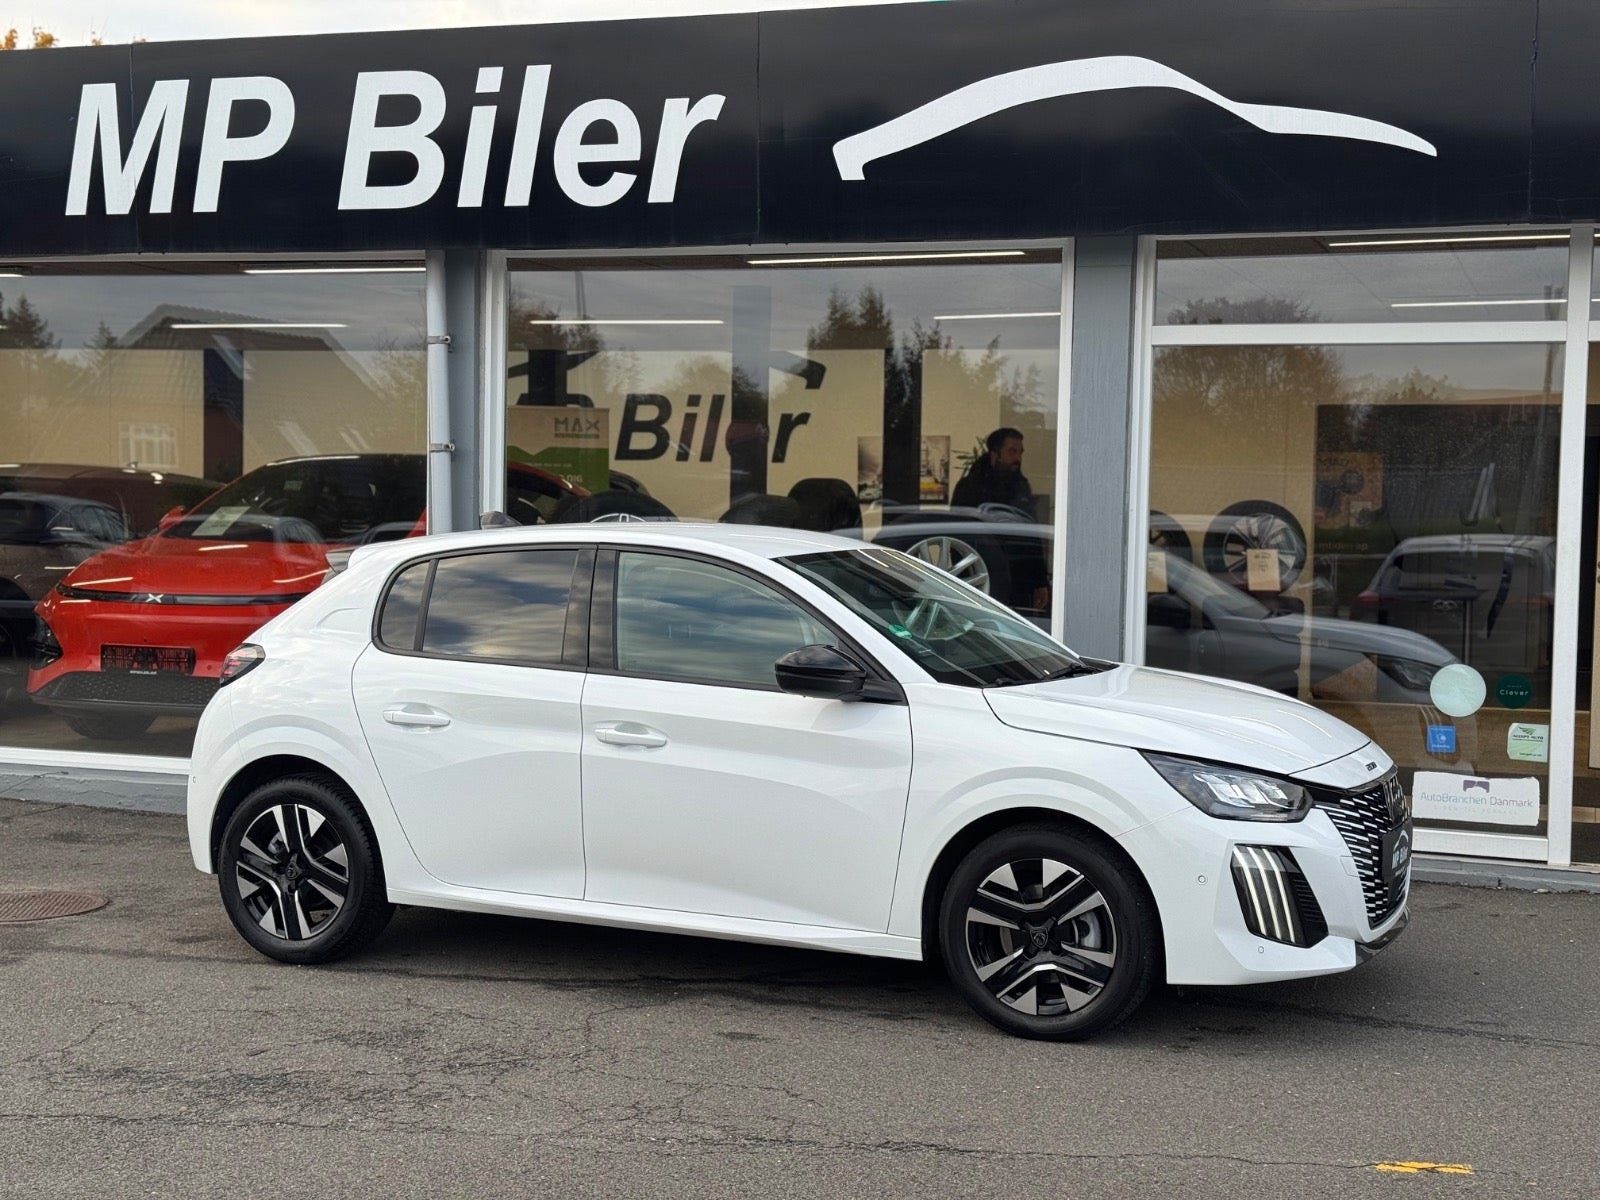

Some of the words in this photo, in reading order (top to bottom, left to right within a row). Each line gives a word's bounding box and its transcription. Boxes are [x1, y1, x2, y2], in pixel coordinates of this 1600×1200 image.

[65, 76, 296, 217] MP
[337, 64, 726, 211] Biler
[553, 417, 600, 433] MAX
[614, 393, 811, 464] Bilr
[1420, 791, 1487, 806] AutoBranchen
[1489, 796, 1533, 808] Danmark
